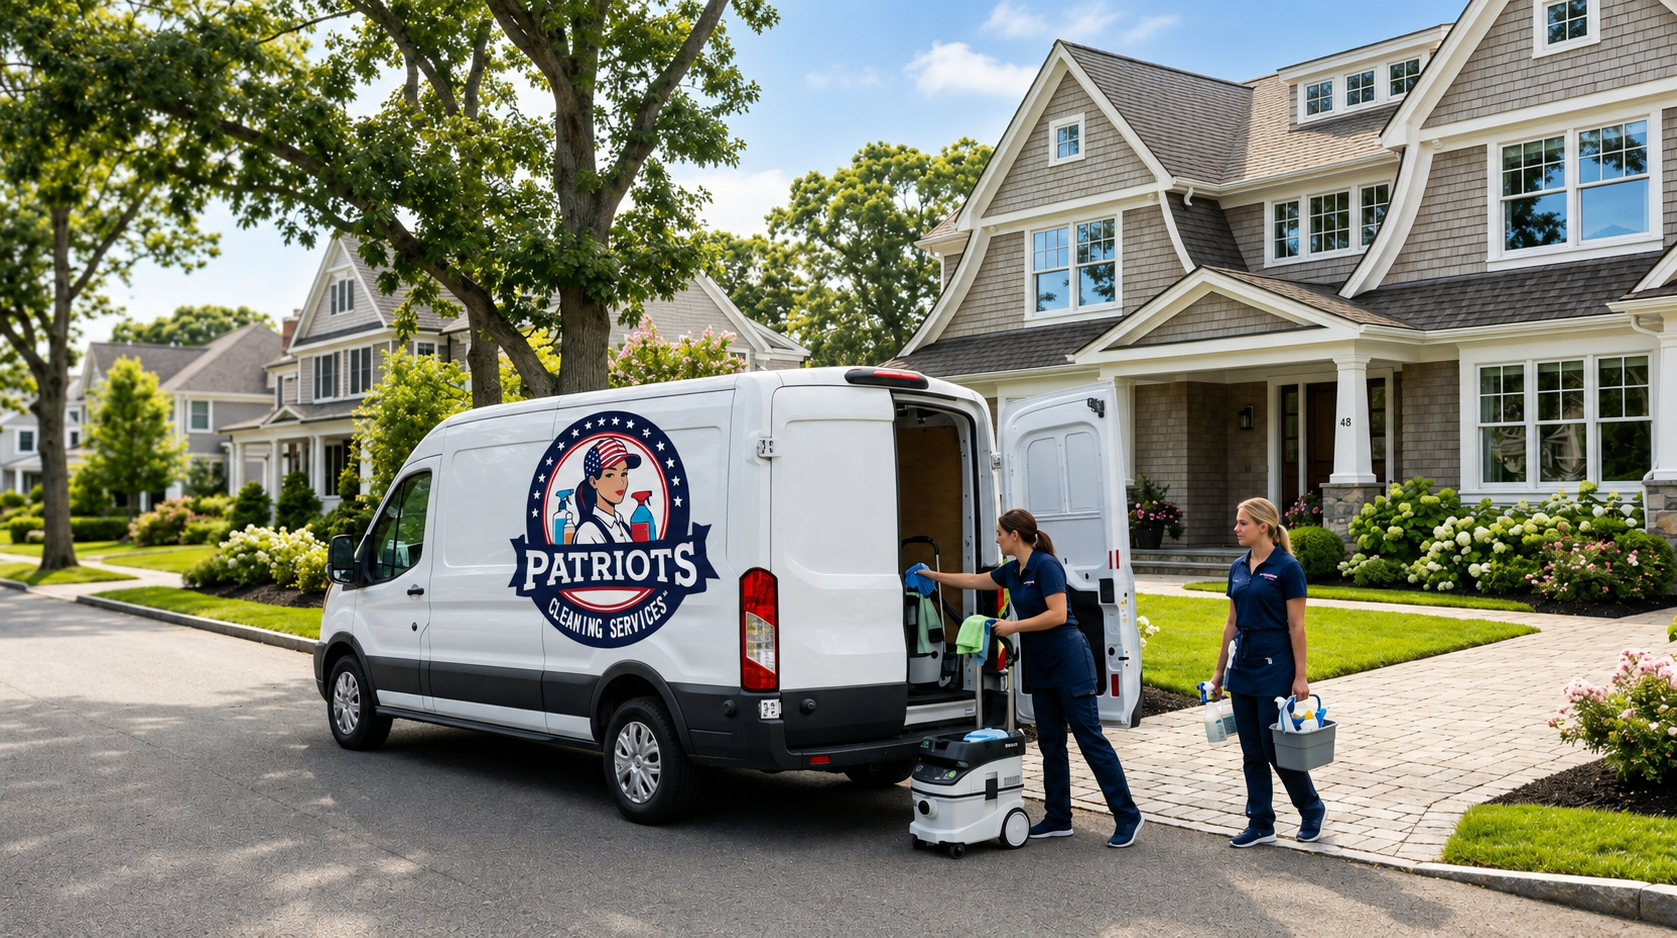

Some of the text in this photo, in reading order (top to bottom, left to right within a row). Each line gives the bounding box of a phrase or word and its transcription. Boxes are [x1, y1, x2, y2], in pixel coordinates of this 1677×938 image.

[1340, 417, 1352, 428] 48
[523, 541, 698, 592] PATRIOTS
[548, 595, 667, 639] CLEANING SERVICES
